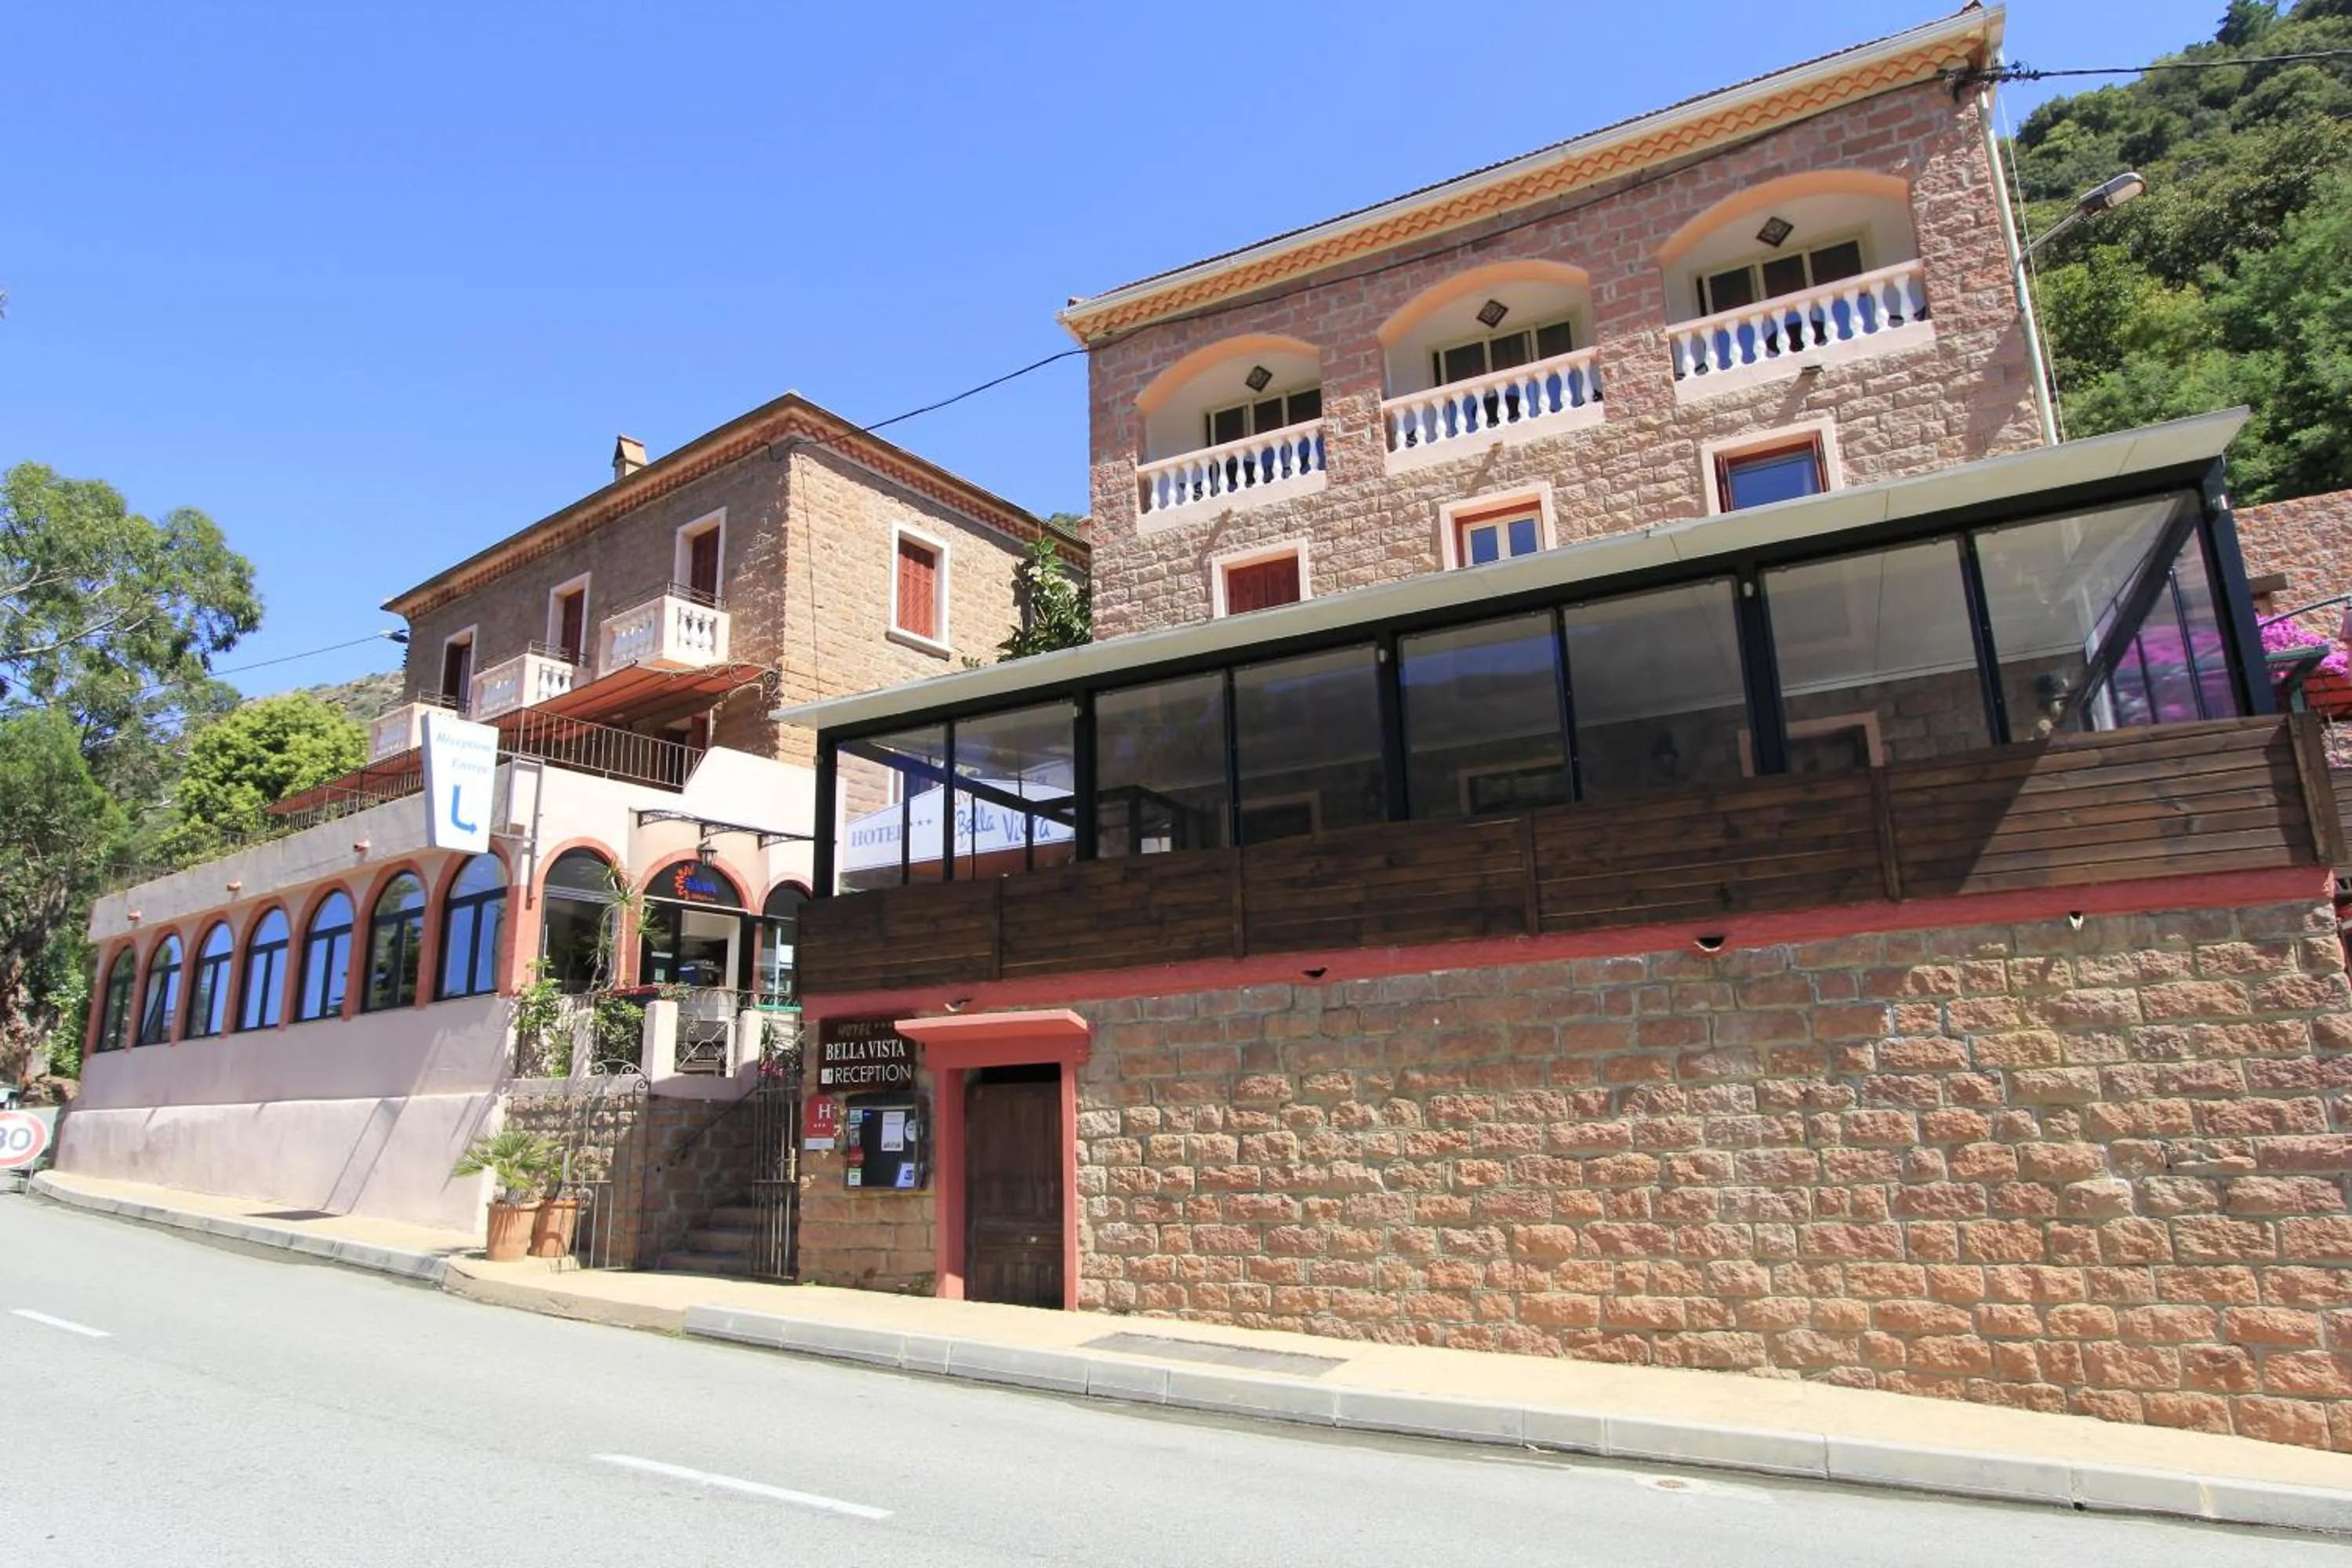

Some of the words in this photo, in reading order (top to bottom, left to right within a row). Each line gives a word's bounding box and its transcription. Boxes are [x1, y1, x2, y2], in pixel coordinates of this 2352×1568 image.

[1002, 811, 1051, 842] Via
[837, 1022, 871, 1037] HOTEL
[826, 1042, 866, 1060] BELLA
[868, 1038, 906, 1058] VISTA
[835, 1064, 912, 1083] RECEPTION
[818, 1103, 831, 1120] H
